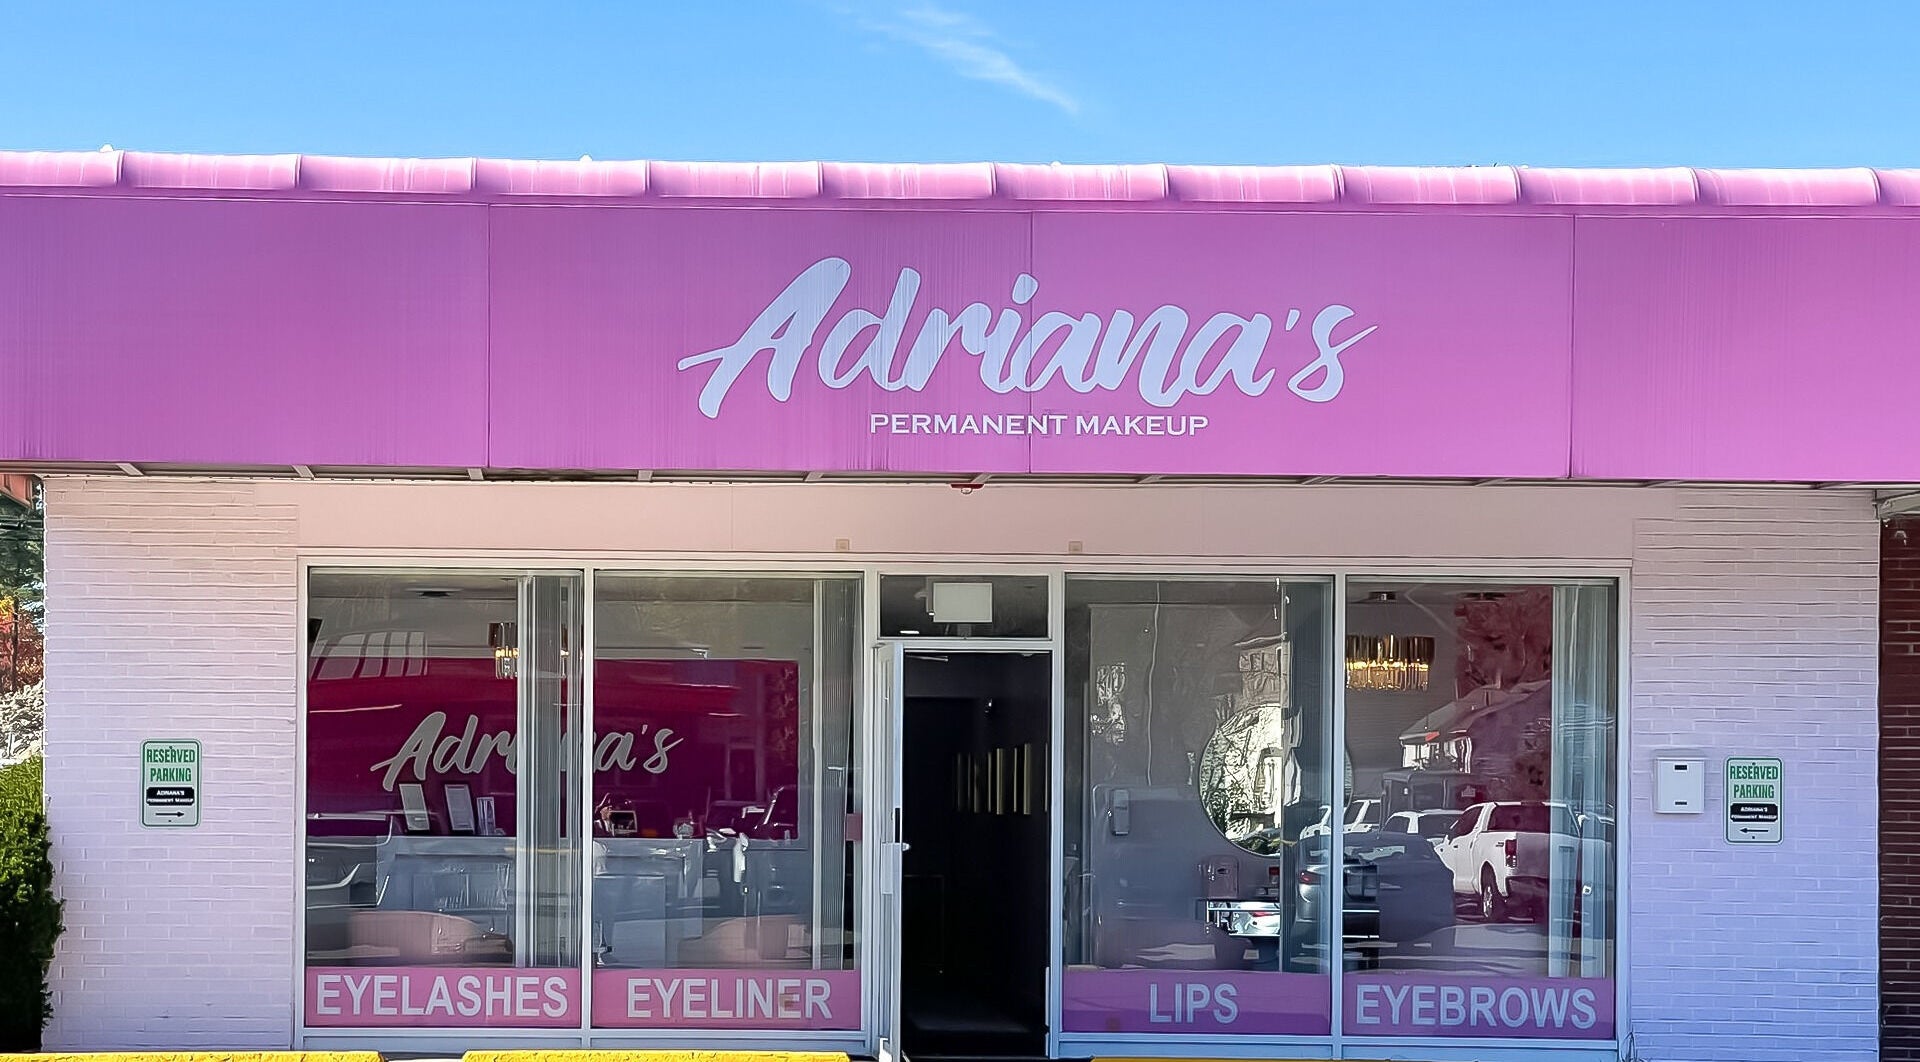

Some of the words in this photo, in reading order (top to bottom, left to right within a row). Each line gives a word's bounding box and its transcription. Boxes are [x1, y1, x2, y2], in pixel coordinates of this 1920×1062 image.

[677, 256, 1378, 419] Adriana's
[870, 413, 1066, 436] PERMANENT
[1075, 414, 1209, 436] MAKEUP
[146, 748, 195, 763] RESERVED
[370, 711, 684, 791] Adra's
[150, 767, 192, 782] PARKING
[1730, 765, 1778, 780] RESERVED
[1734, 784, 1775, 799] PARKING
[316, 974, 569, 1018] EYELASHES
[627, 978, 832, 1019] EYELINER
[1149, 983, 1239, 1024] LIPS
[1356, 984, 1597, 1030] EYEBROWS
